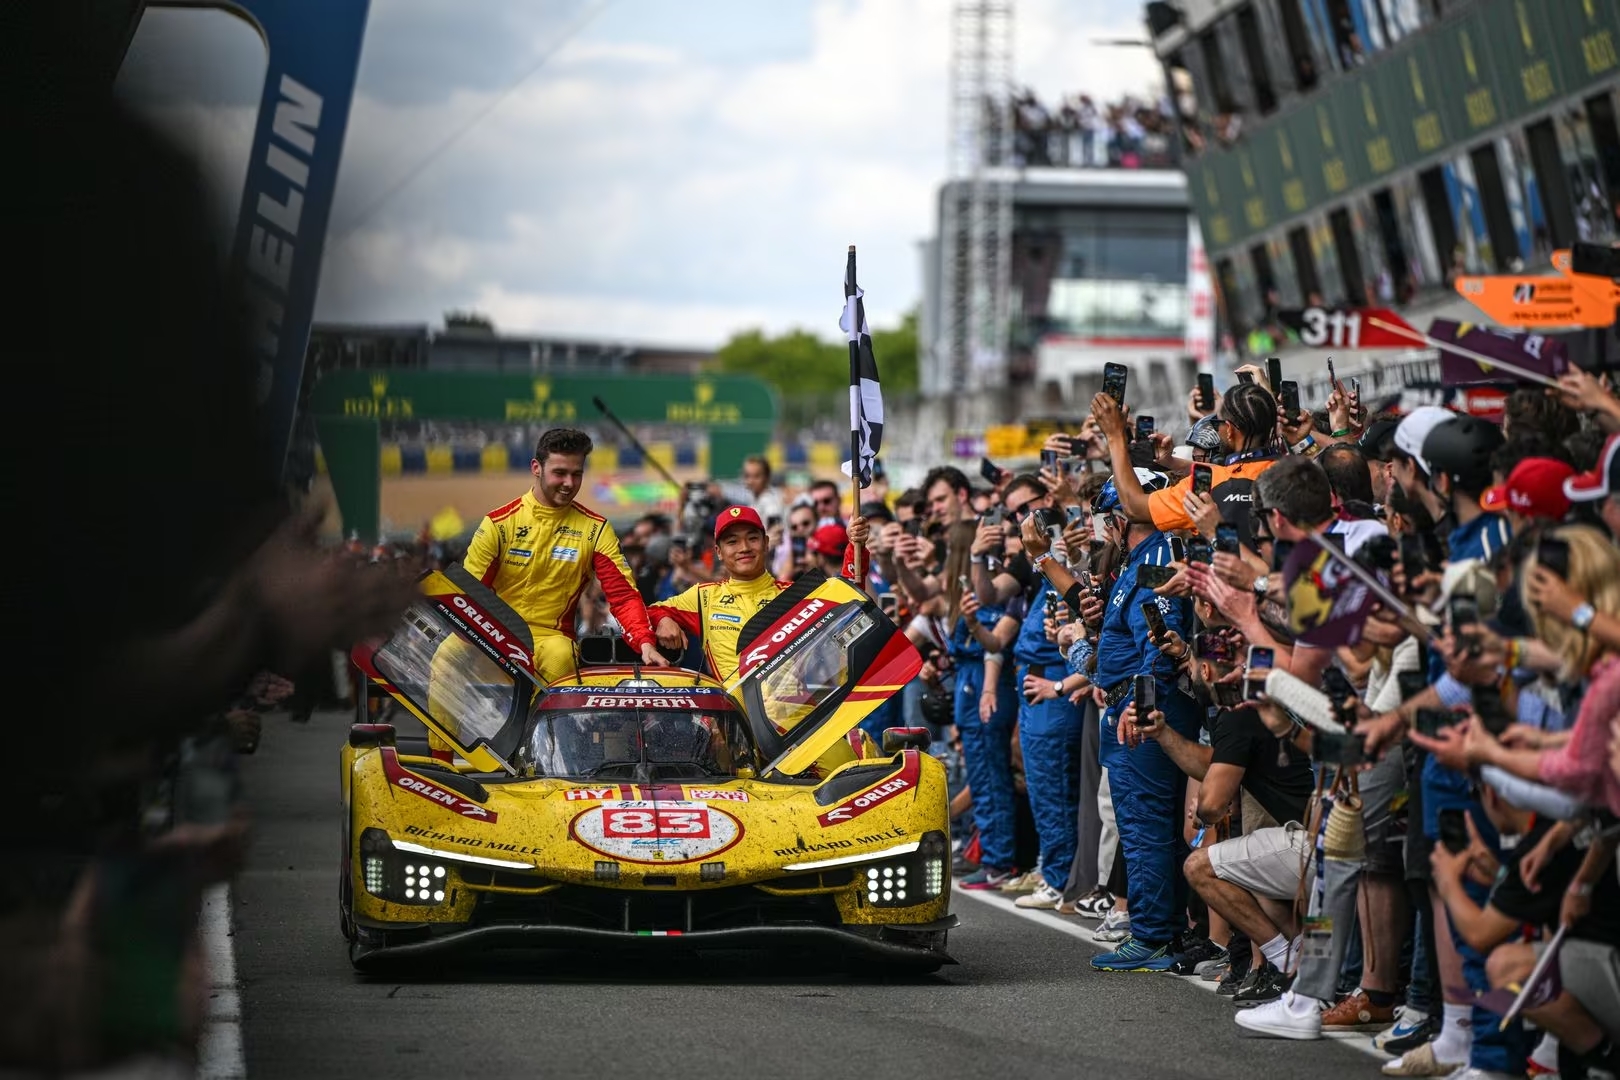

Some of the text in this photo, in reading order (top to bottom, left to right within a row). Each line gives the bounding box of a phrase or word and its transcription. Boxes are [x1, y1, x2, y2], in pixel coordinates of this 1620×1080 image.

[1301, 308, 1361, 347] 311
[452, 595, 505, 643] ORLEN
[771, 598, 825, 643] ORLEN
[581, 695, 700, 708] Ferrari
[398, 777, 458, 806] ORLEN
[566, 789, 613, 800] HY
[854, 778, 910, 807] ORLEN
[609, 811, 704, 834] 83
[404, 825, 544, 856] RICHARD MILLE
[773, 826, 907, 857] RICHARD MILLE
